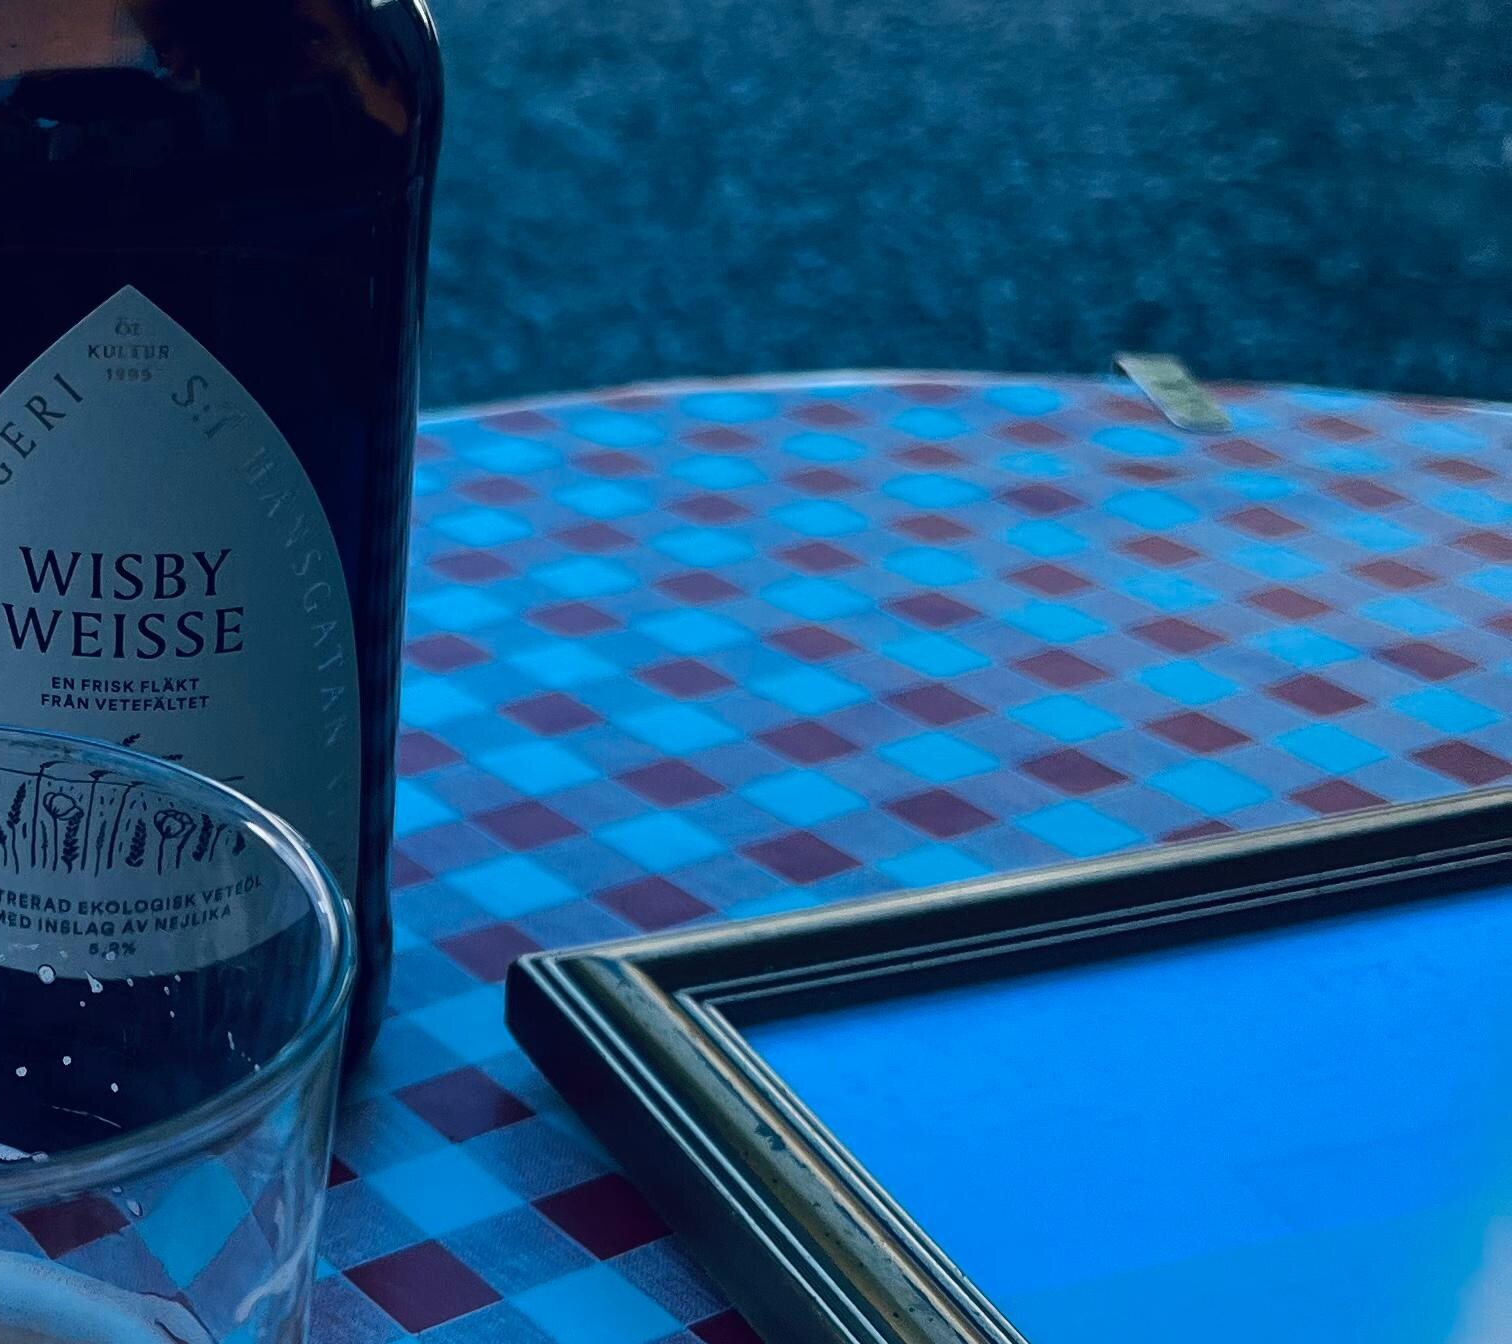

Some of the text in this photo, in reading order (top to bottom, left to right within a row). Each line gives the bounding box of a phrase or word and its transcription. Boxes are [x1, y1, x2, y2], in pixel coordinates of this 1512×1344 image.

[88, 344, 170, 359] KULTUR
[19, 546, 232, 601] WISBY
[2, 602, 244, 660] WEISSE
[51, 677, 199, 693] EN FRISK FLÄKT
[41, 693, 209, 711] FRÅN VETEFÄLTET
[79, 894, 196, 915] EKOLOGISK
[202, 873, 262, 903] VETEÖL
[39, 919, 114, 937] INSLAG
[121, 918, 149, 934] AV
[154, 906, 232, 931] NEJLIKA
